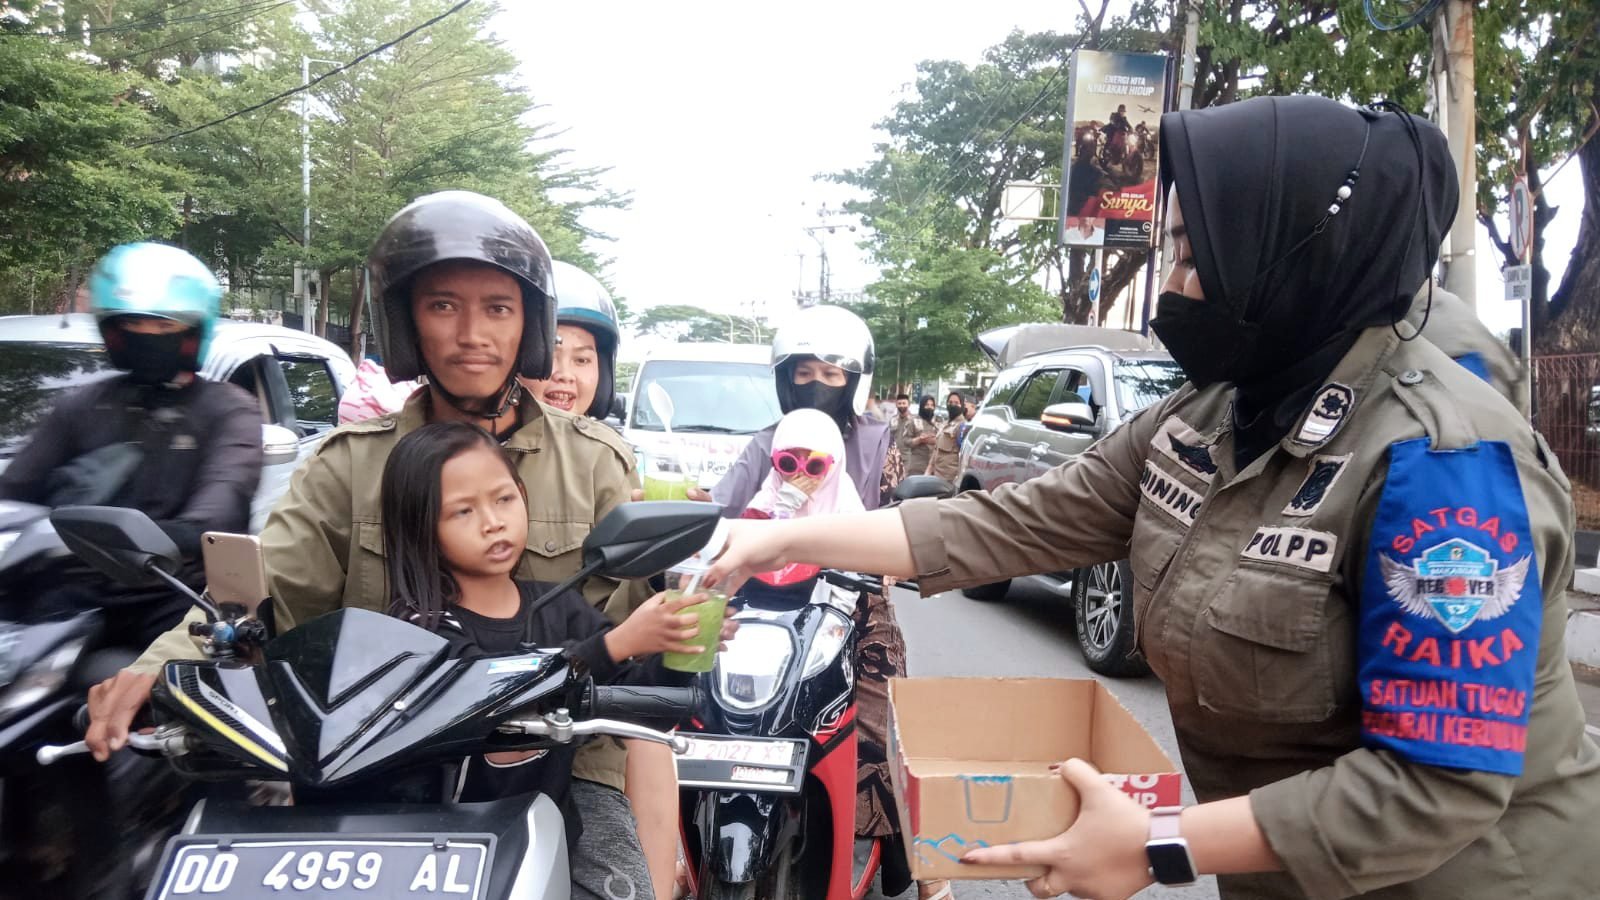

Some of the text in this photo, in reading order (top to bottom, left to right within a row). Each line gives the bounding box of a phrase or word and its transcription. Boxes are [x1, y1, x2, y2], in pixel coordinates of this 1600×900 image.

[1104, 74, 1129, 84] ENERGI
[1128, 86, 1154, 96] HIDUP
[1100, 191, 1154, 218] Surya
[1392, 506, 1519, 554] SATGAS
[1382, 621, 1525, 669] RAIKA
[1370, 679, 1527, 718] SATUAN TUGAS
[262, 851, 383, 891] 4959
[408, 853, 470, 893] AL
